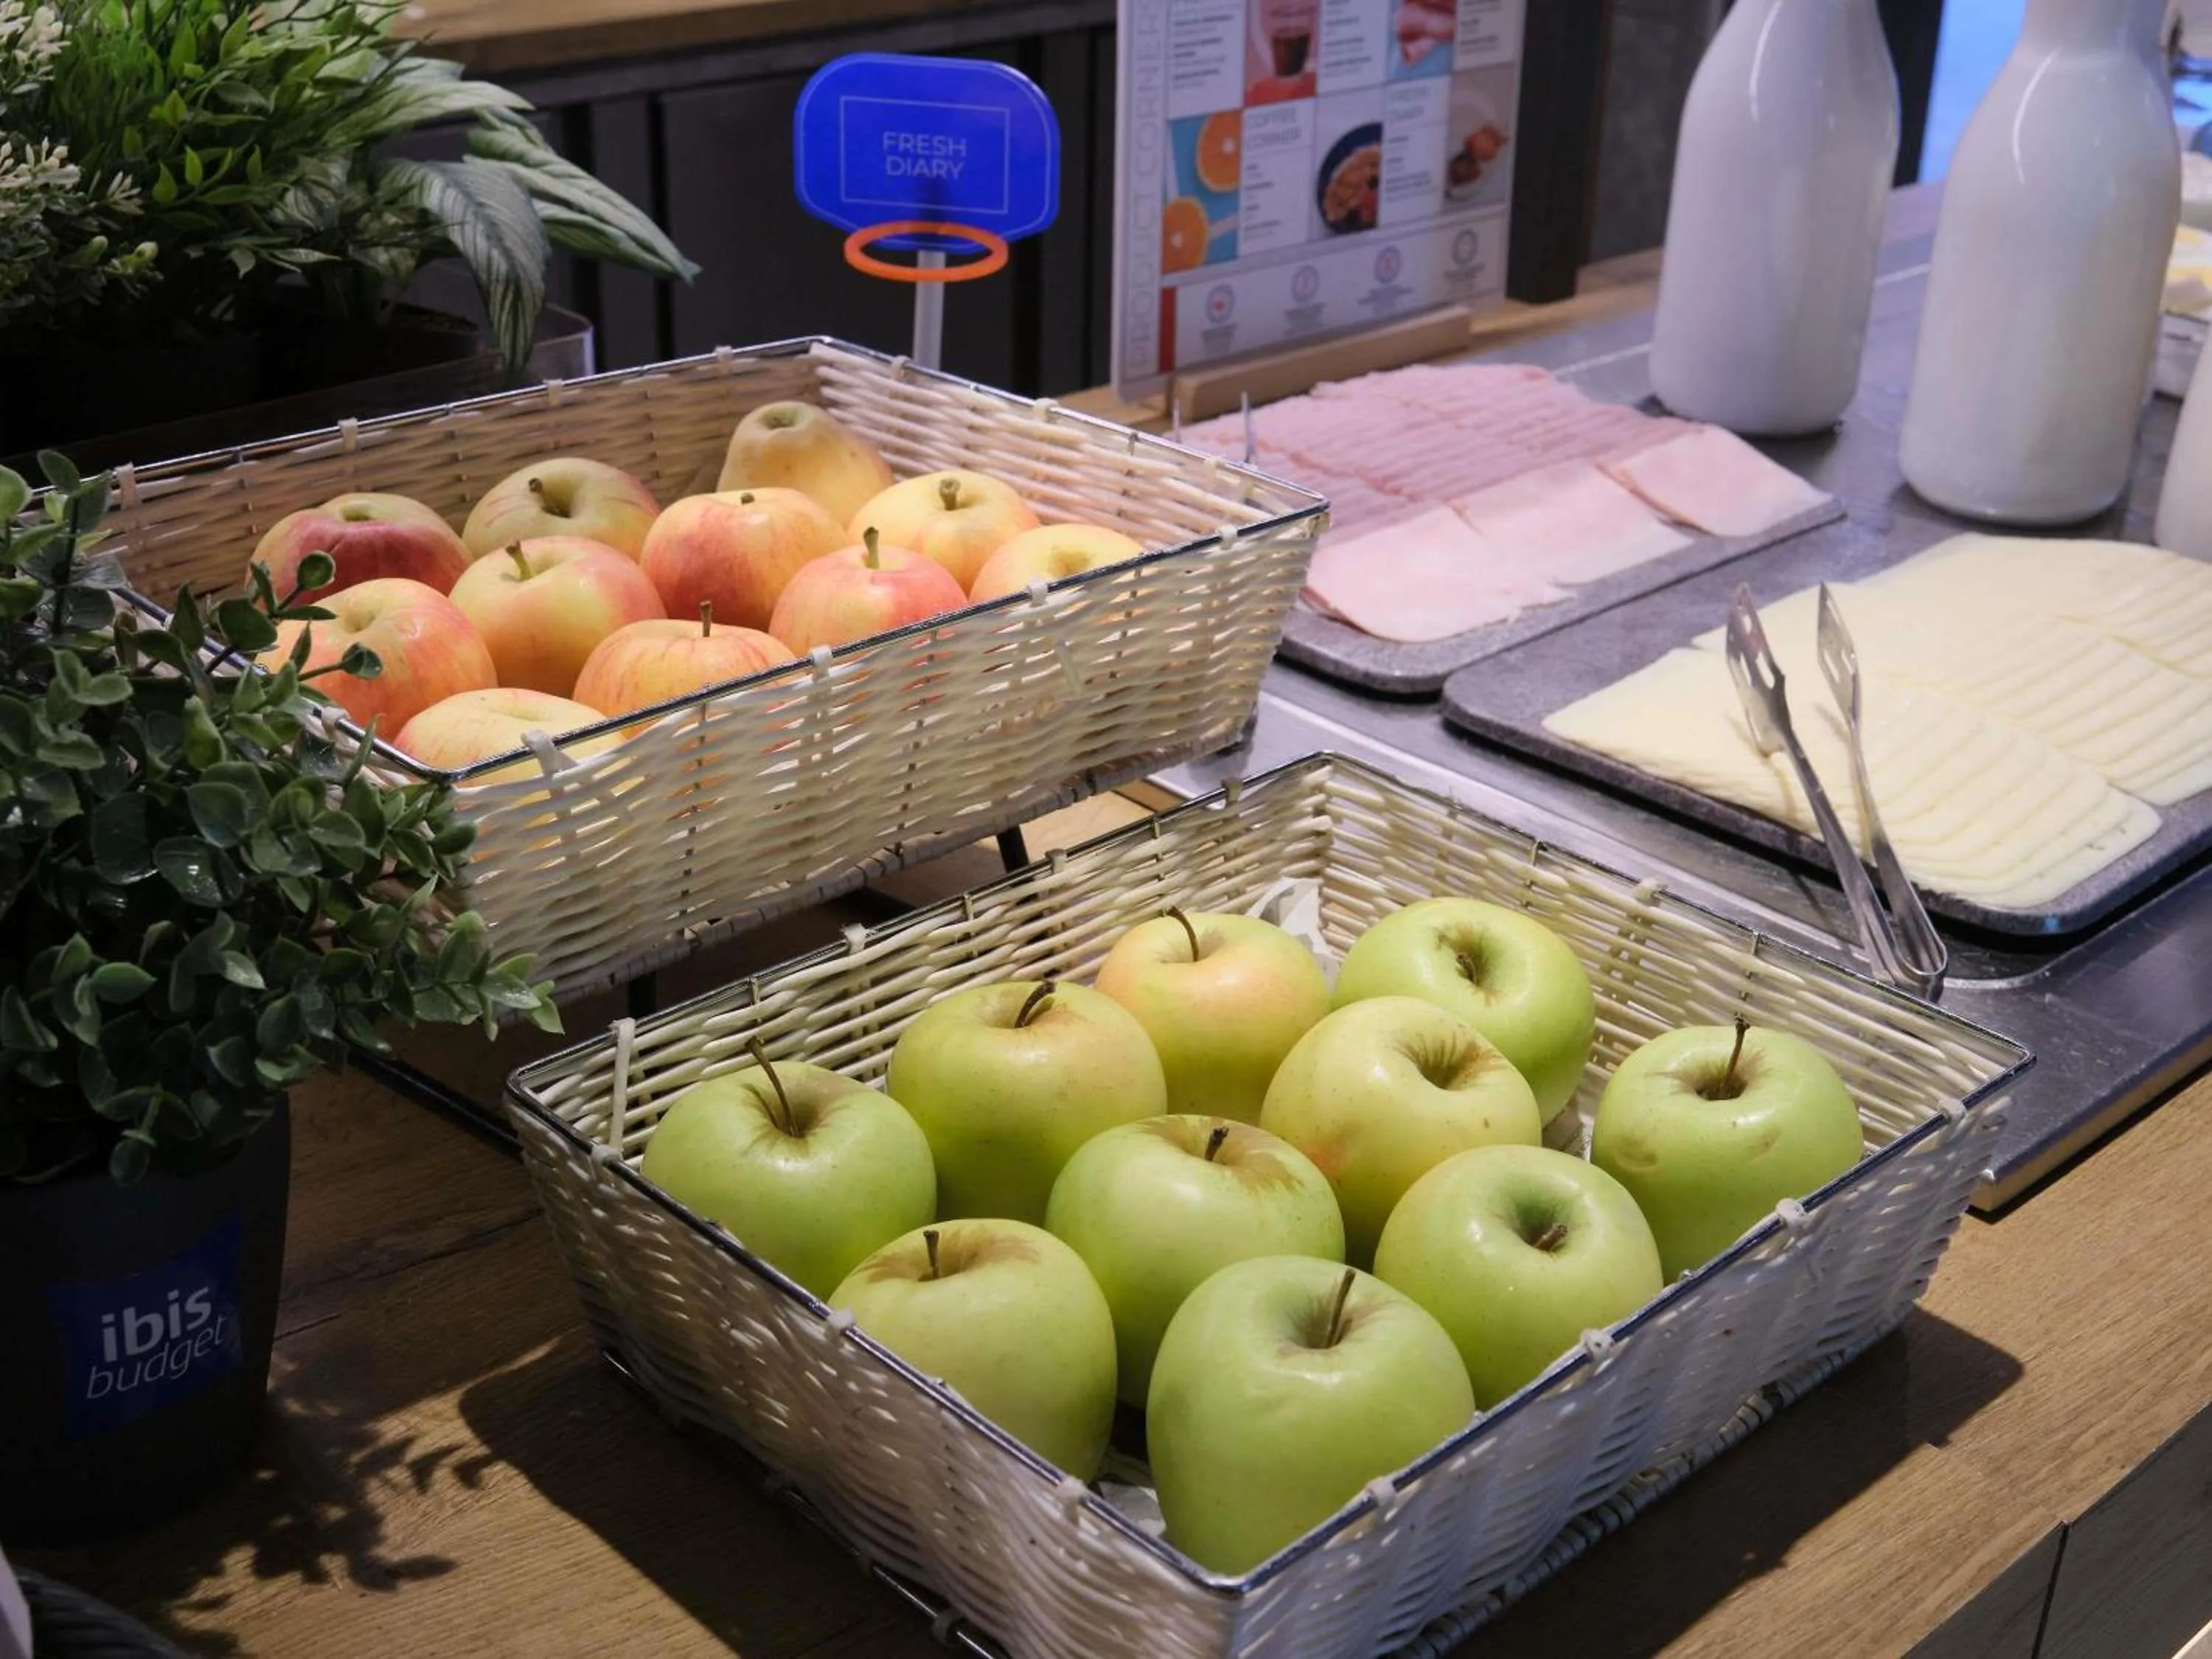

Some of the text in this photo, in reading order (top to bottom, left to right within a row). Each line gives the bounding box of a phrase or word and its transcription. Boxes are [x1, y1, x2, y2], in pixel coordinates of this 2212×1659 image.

[883, 131, 967, 157] FRESH
[886, 155, 964, 180] DIARY
[101, 1286, 212, 1363] ibis
[86, 1315, 228, 1399] budget
